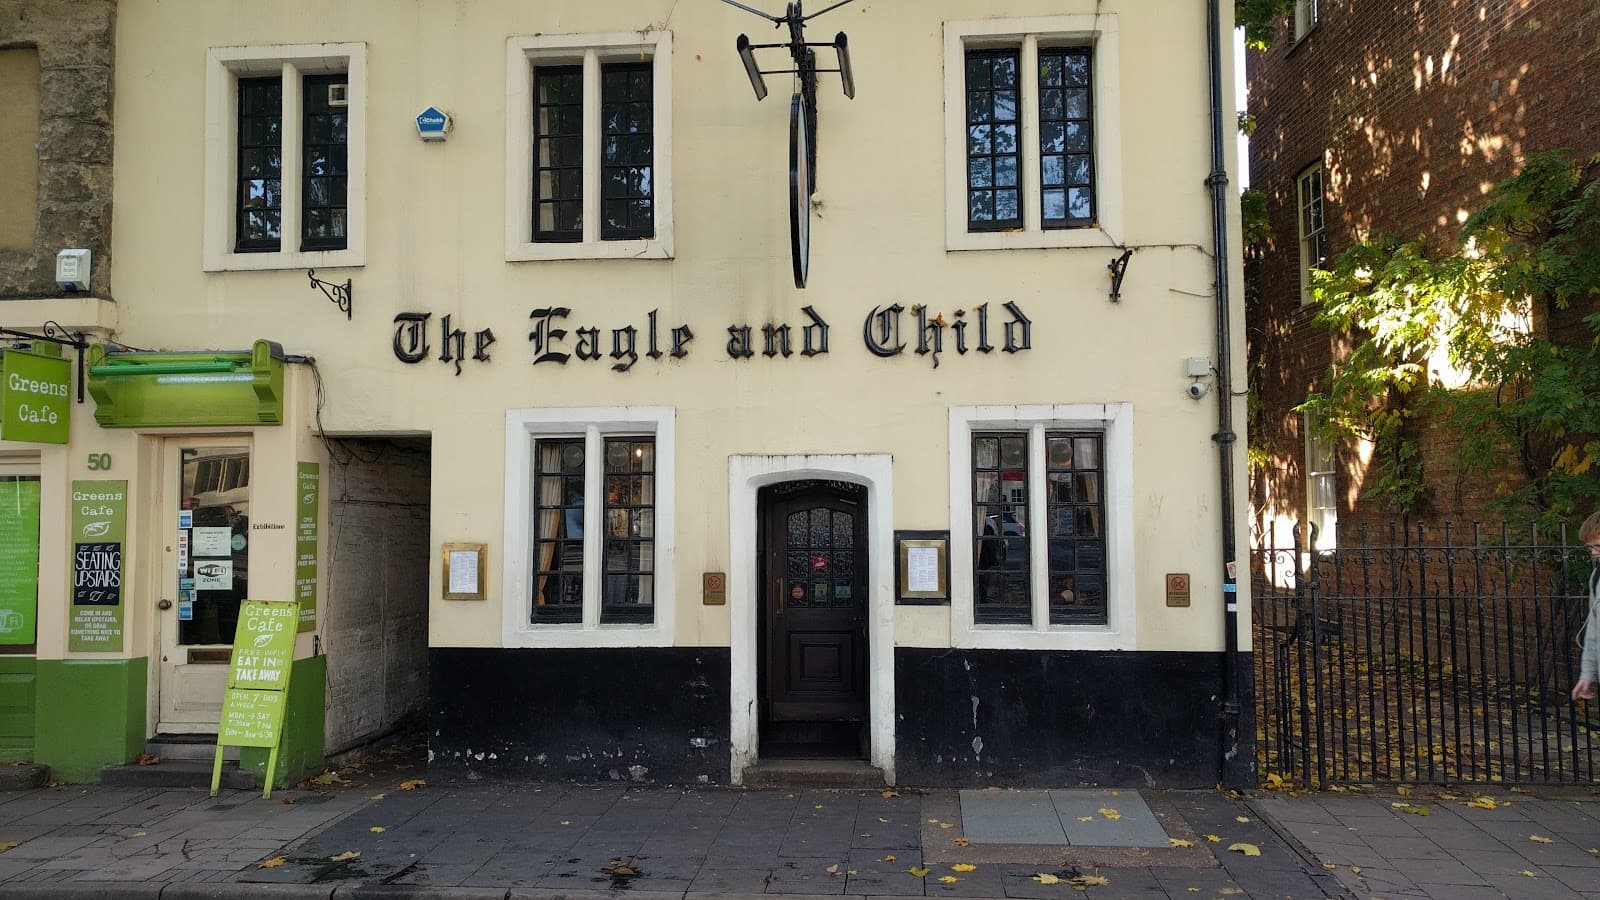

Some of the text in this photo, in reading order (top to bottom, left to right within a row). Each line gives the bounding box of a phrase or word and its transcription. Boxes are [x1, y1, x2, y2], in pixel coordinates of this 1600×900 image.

[393, 301, 1033, 376] The Eagle and Child
[9, 373, 68, 397] Greens
[18, 404, 58, 425] Cafe
[87, 453, 112, 471] 50
[73, 491, 122, 501] Greens
[81, 506, 113, 516] Cafe
[76, 551, 120, 570] SEATING
[75, 570, 120, 588] UPSTAIRS
[245, 604, 293, 617] Greens
[247, 617, 283, 632] Cafe
[237, 656, 259, 666] EAT
[236, 668, 281, 681] TAKE AWAY
[231, 692, 279, 703] OPEN 7 DAYS
[229, 711, 271, 720] MON SAT
